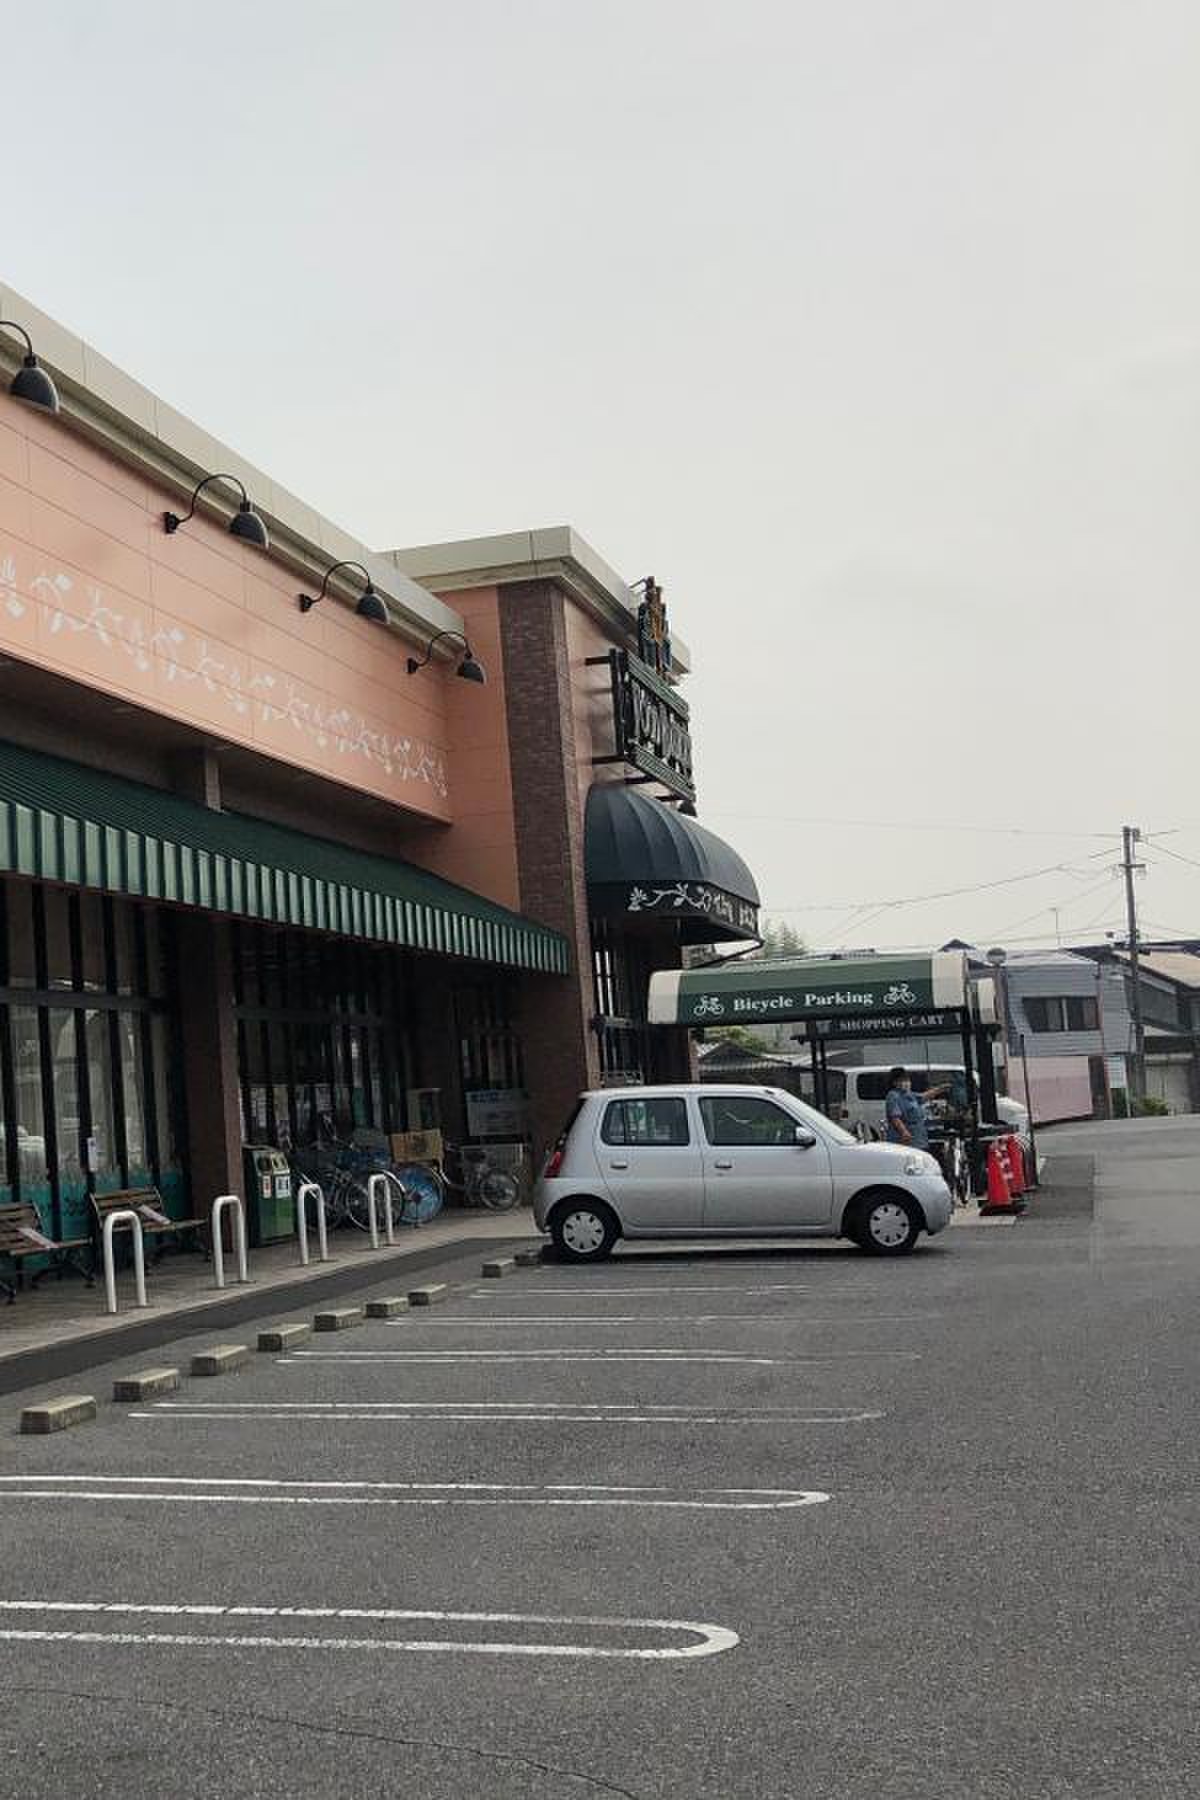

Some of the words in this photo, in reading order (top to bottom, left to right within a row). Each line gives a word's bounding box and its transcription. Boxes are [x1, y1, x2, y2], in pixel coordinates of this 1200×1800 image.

[733, 996, 794, 1013] Bicycle
[804, 991, 874, 1007] Parking
[838, 1016, 905, 1031] SHOPPING
[909, 1014, 945, 1027] CART
